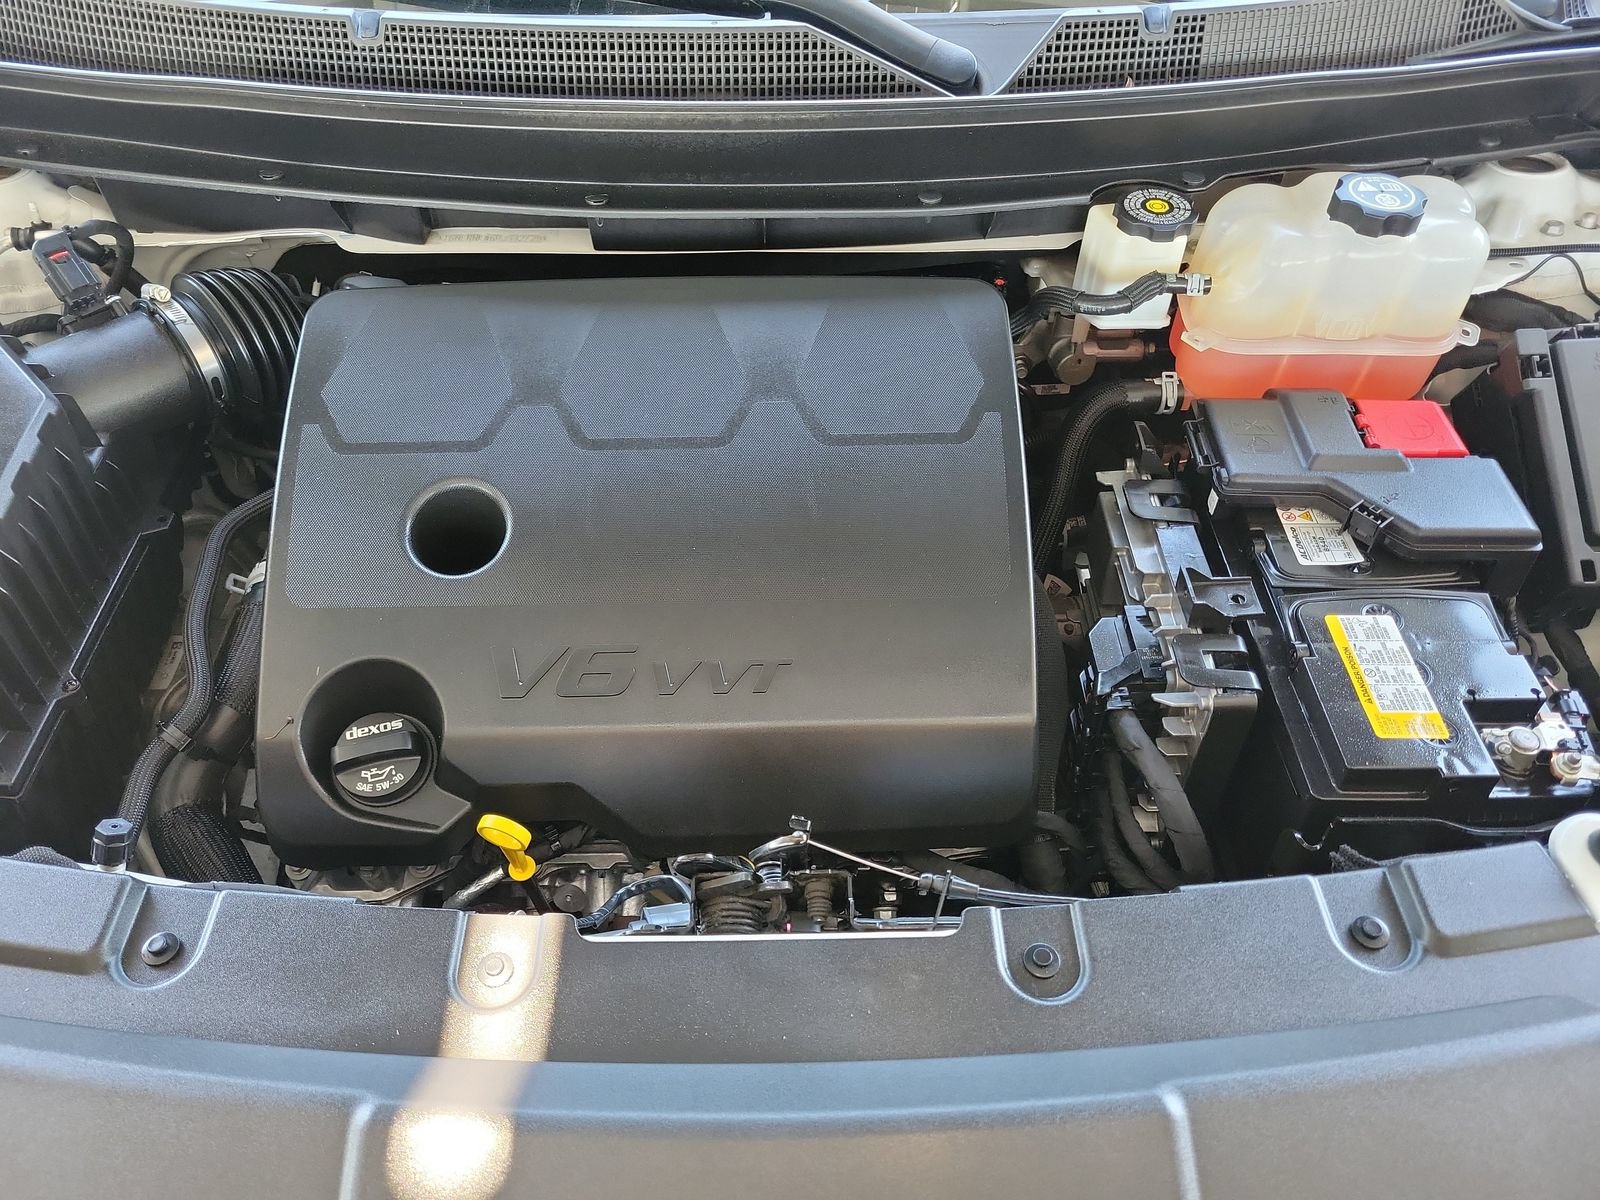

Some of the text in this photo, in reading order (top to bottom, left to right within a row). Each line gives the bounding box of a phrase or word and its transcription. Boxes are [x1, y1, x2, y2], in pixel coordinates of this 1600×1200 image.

[488, 643, 793, 699] V6 VVT
[345, 718, 404, 740] dexos
[355, 773, 405, 792] SAE 5W-30
